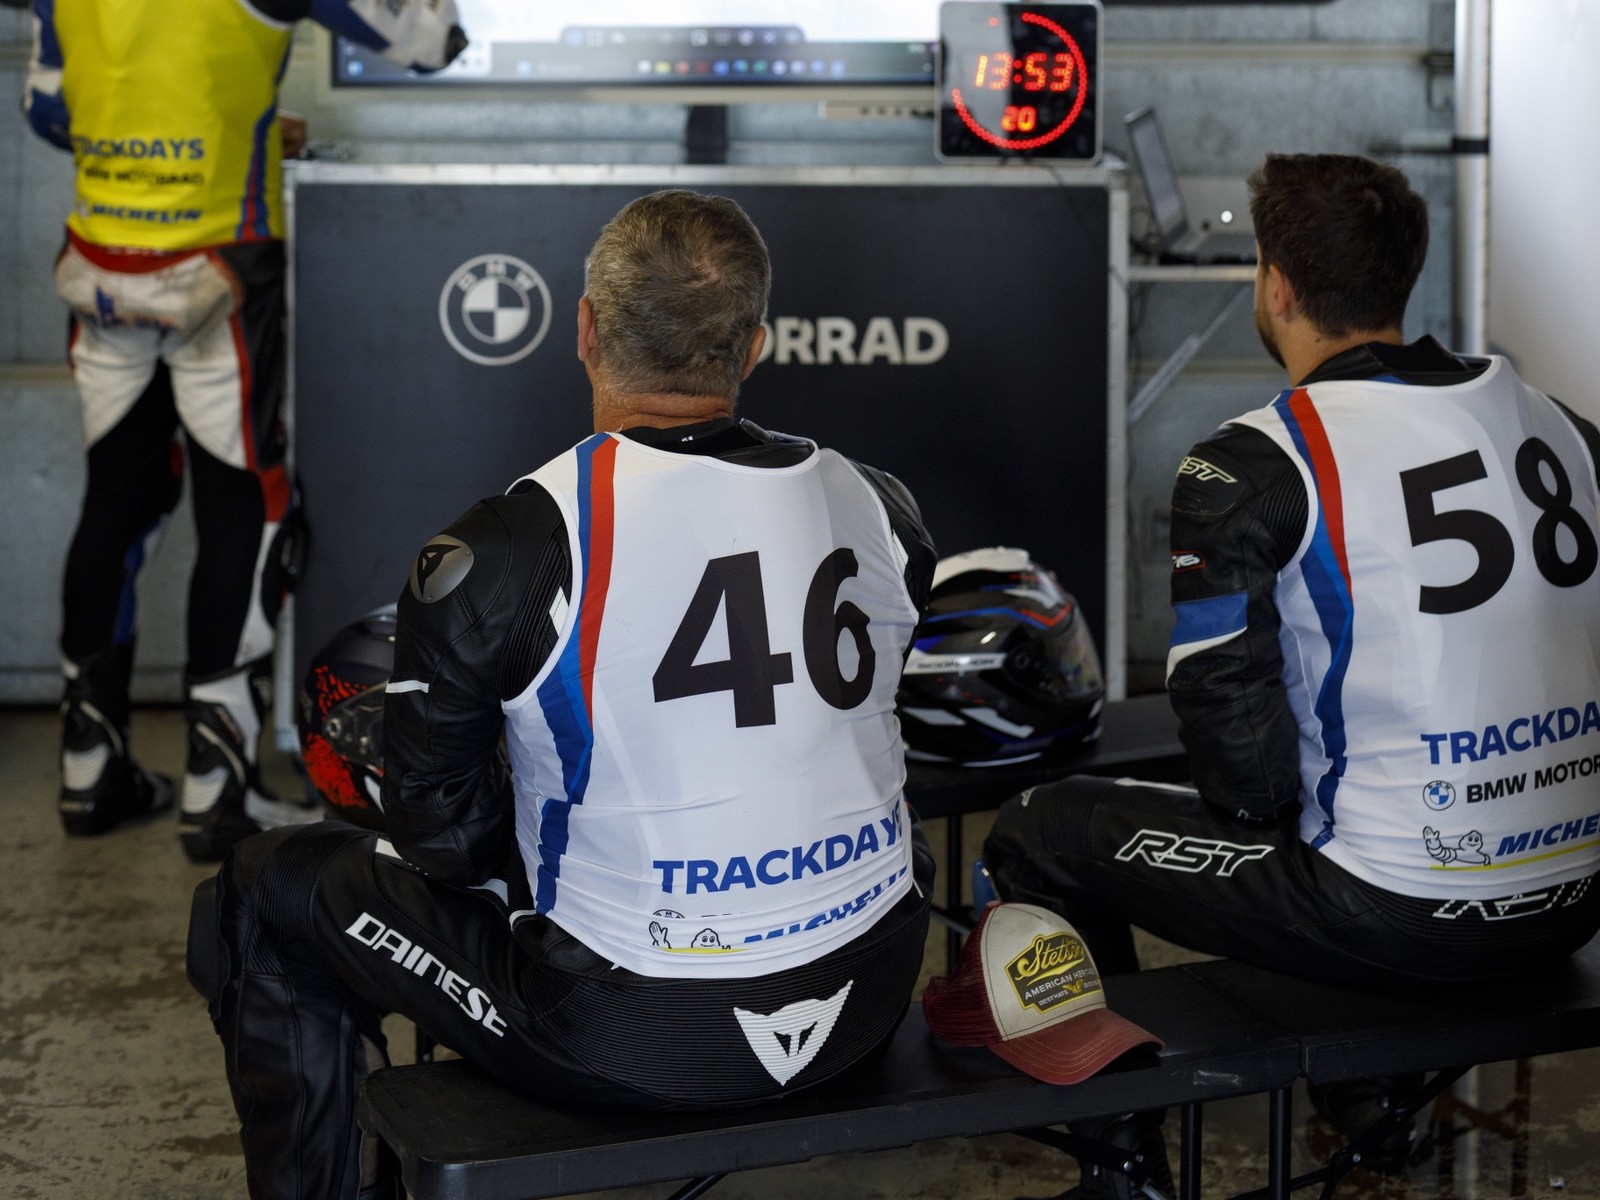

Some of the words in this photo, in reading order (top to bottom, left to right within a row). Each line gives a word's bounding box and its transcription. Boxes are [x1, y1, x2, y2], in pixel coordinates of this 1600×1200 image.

[974, 52, 1076, 92] 13:53
[1001, 105, 1037, 132] 20
[1399, 436, 1599, 615] 58
[652, 547, 877, 728] 46
[1420, 700, 1600, 765] TRACKDA
[1466, 772, 1527, 804] BMW
[1114, 829, 1275, 877] RST
[344, 911, 508, 1038] DAINESE
[1024, 974, 1073, 1000] AMERICAN
